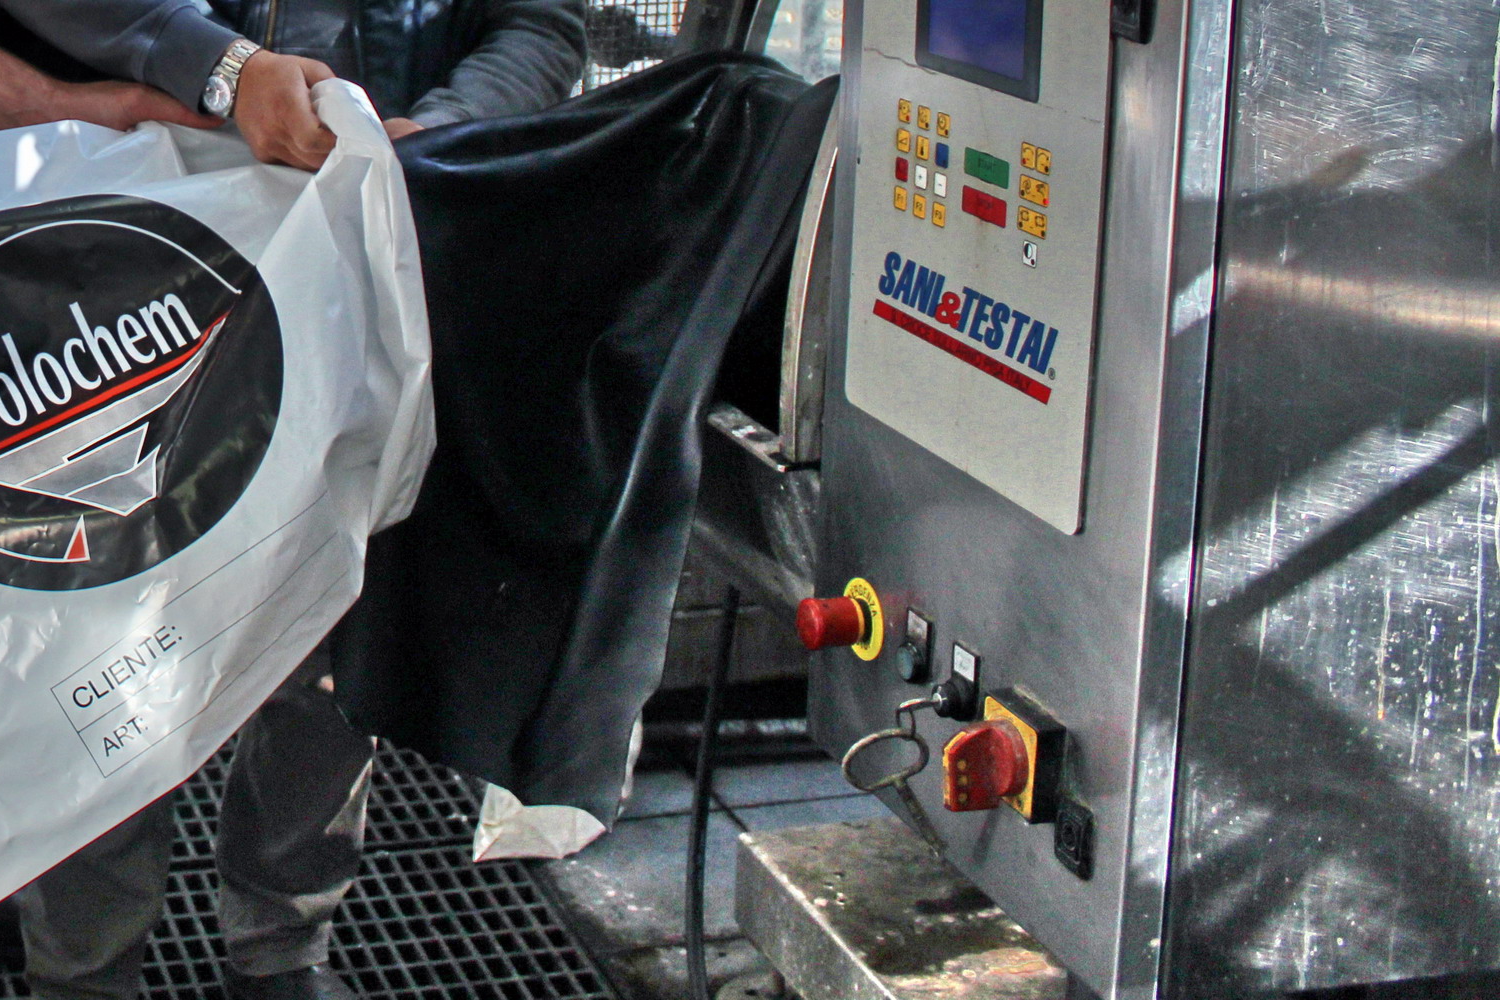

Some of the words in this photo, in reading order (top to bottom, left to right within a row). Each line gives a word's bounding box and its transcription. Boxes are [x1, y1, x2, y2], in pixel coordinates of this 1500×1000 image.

[878, 251, 1059, 375] SANI&TESTAI
[72, 625, 182, 708] CLIENTE:
[102, 715, 149, 758] ART:
